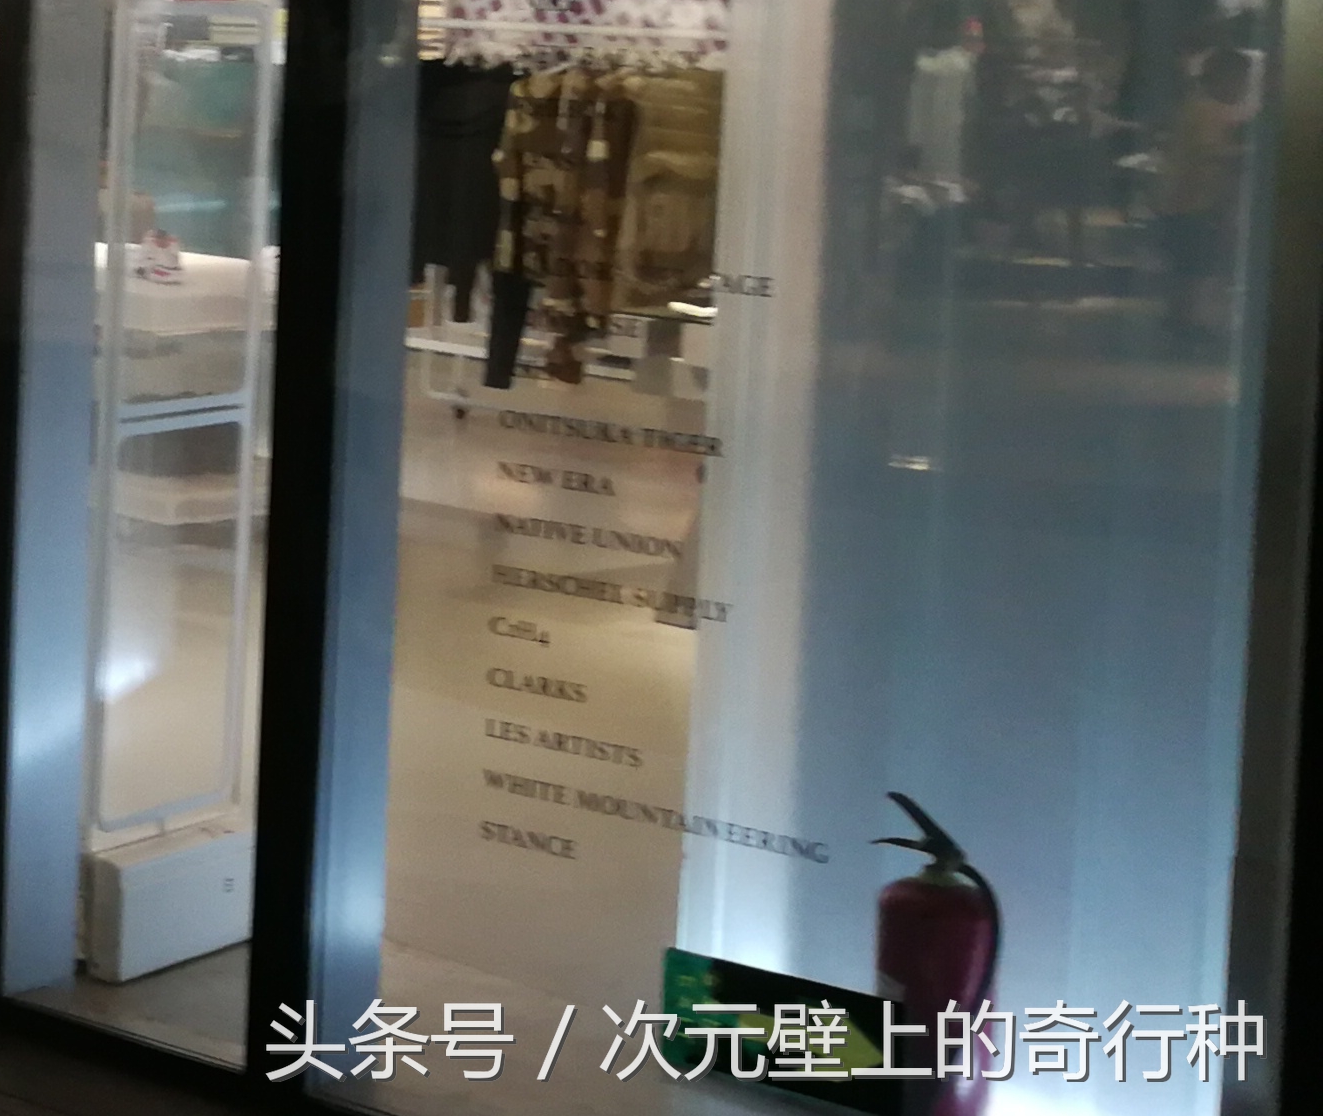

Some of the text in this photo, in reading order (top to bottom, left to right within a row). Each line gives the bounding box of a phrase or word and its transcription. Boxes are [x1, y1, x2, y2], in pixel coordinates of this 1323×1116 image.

[498, 461, 615, 496] NEW ERA
[485, 667, 588, 703] CLARKS
[484, 718, 643, 768] LES ARTISTS
[482, 768, 830, 864] WHITE MOUNTAINEERING
[478, 819, 578, 860] STANCE
